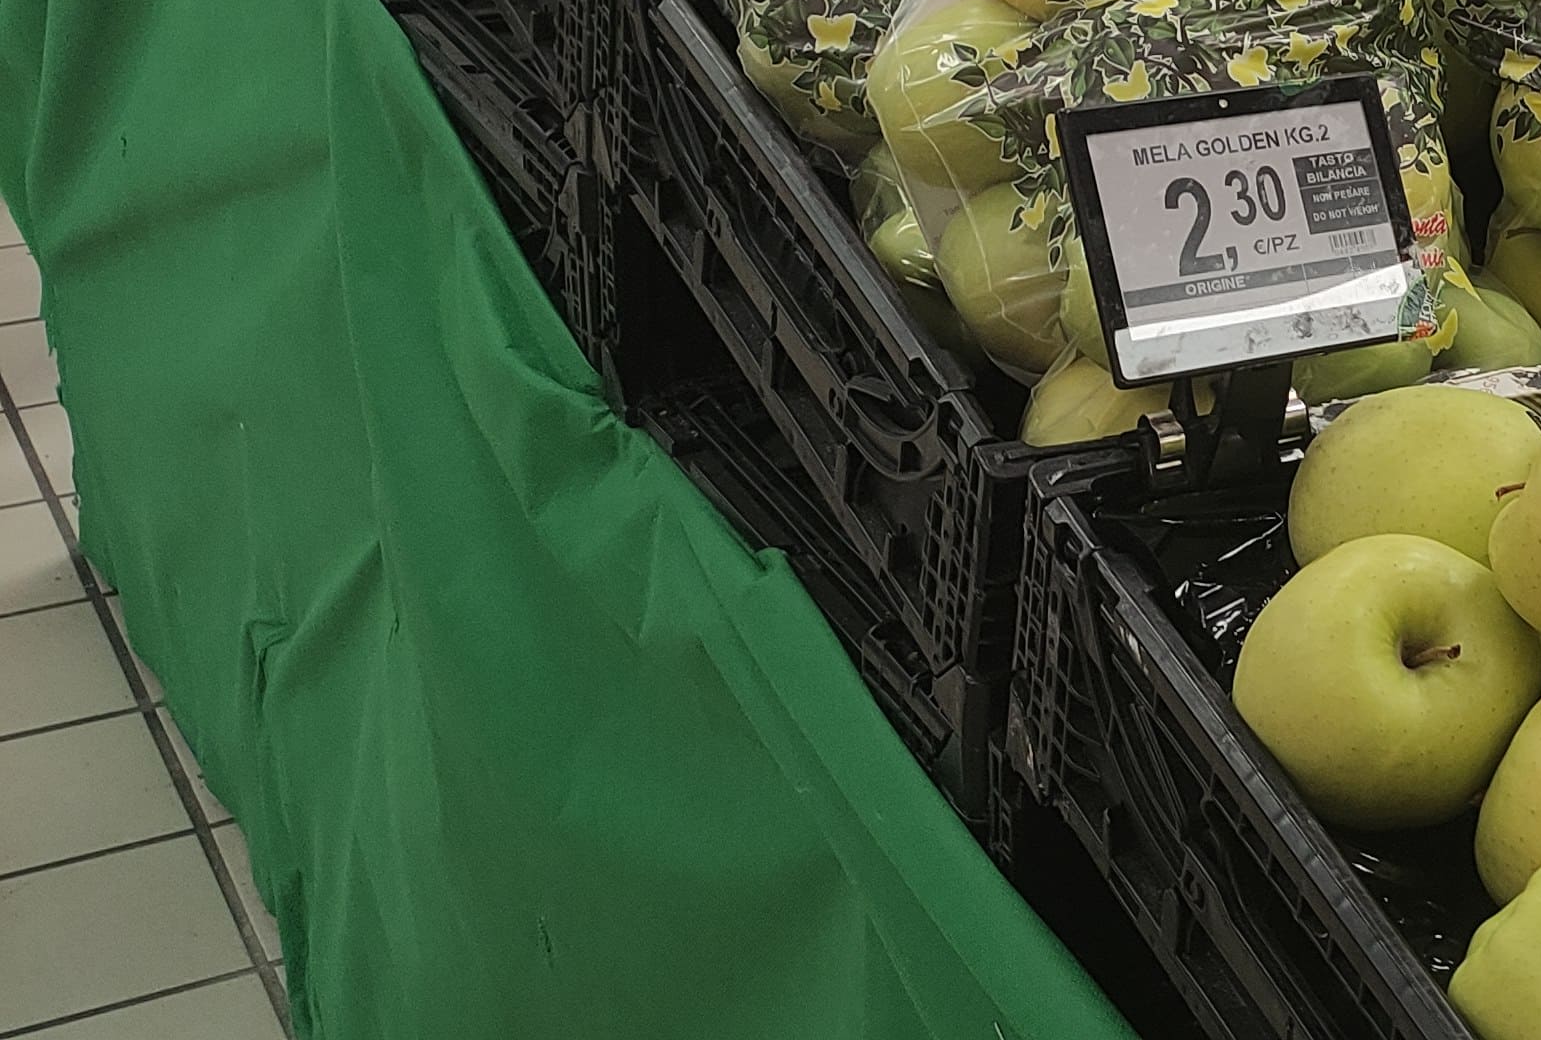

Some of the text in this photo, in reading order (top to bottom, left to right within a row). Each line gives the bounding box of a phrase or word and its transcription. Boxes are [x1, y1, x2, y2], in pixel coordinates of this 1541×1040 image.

[1132, 124, 1331, 166] MELA GOLDEN KG.2
[1309, 153, 1354, 167] TASTO
[1306, 165, 1368, 184] BILANCIA
[1312, 192, 1334, 203] NON
[1164, 165, 1287, 277] 2,30
[1312, 212, 1327, 223] DO
[1328, 209, 1347, 221] NOT
[1253, 234, 1300, 256] €/PZ
[1184, 278, 1247, 298] ORIGINE
